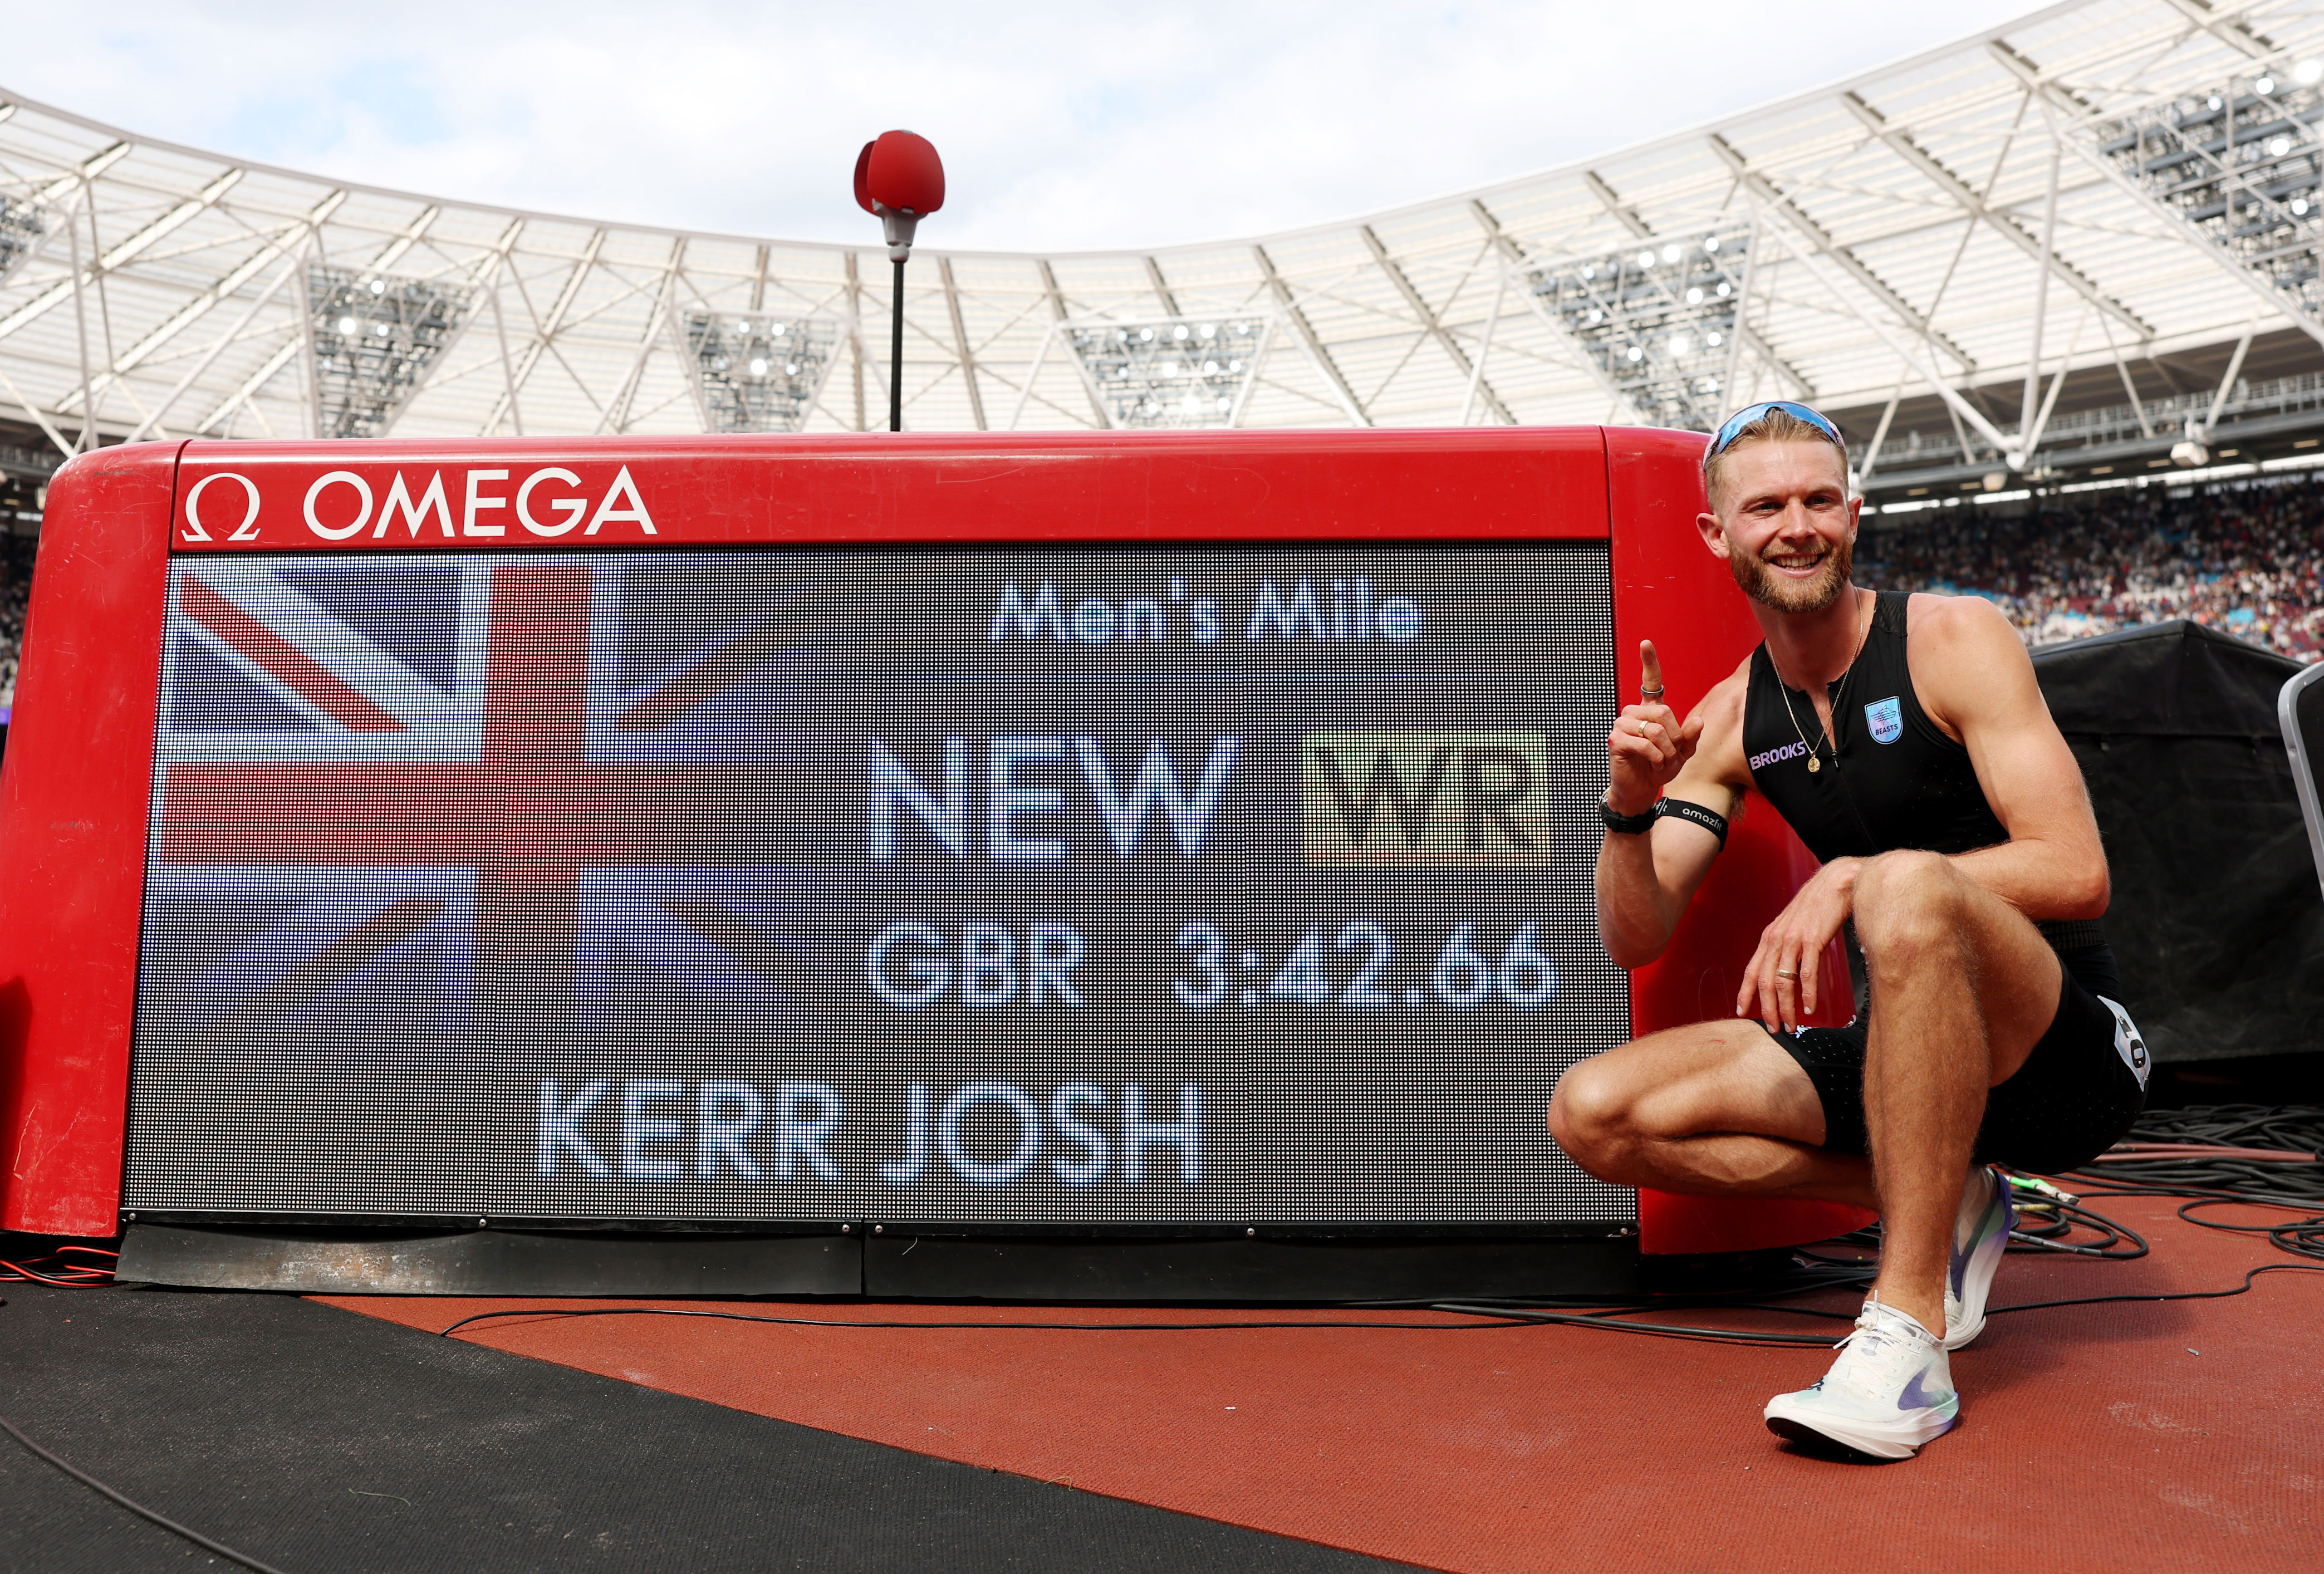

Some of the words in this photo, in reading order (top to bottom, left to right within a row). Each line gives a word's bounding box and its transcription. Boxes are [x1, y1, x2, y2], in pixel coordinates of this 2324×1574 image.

[303, 464, 658, 540] OMEGA
[989, 575, 1222, 644] Men's
[1245, 577, 1425, 644] Mile
[1749, 741, 1806, 770] BROOKS
[1875, 724, 1898, 735] BEASTS
[867, 735, 1239, 862] NEW
[1313, 745, 1536, 853] WR
[1682, 808, 1723, 832] amazfit
[865, 919, 1086, 1008] GBR
[1174, 920, 1558, 1009] 3:42.66
[537, 1077, 842, 1180] KERR
[880, 1082, 1202, 1184] JOSH
